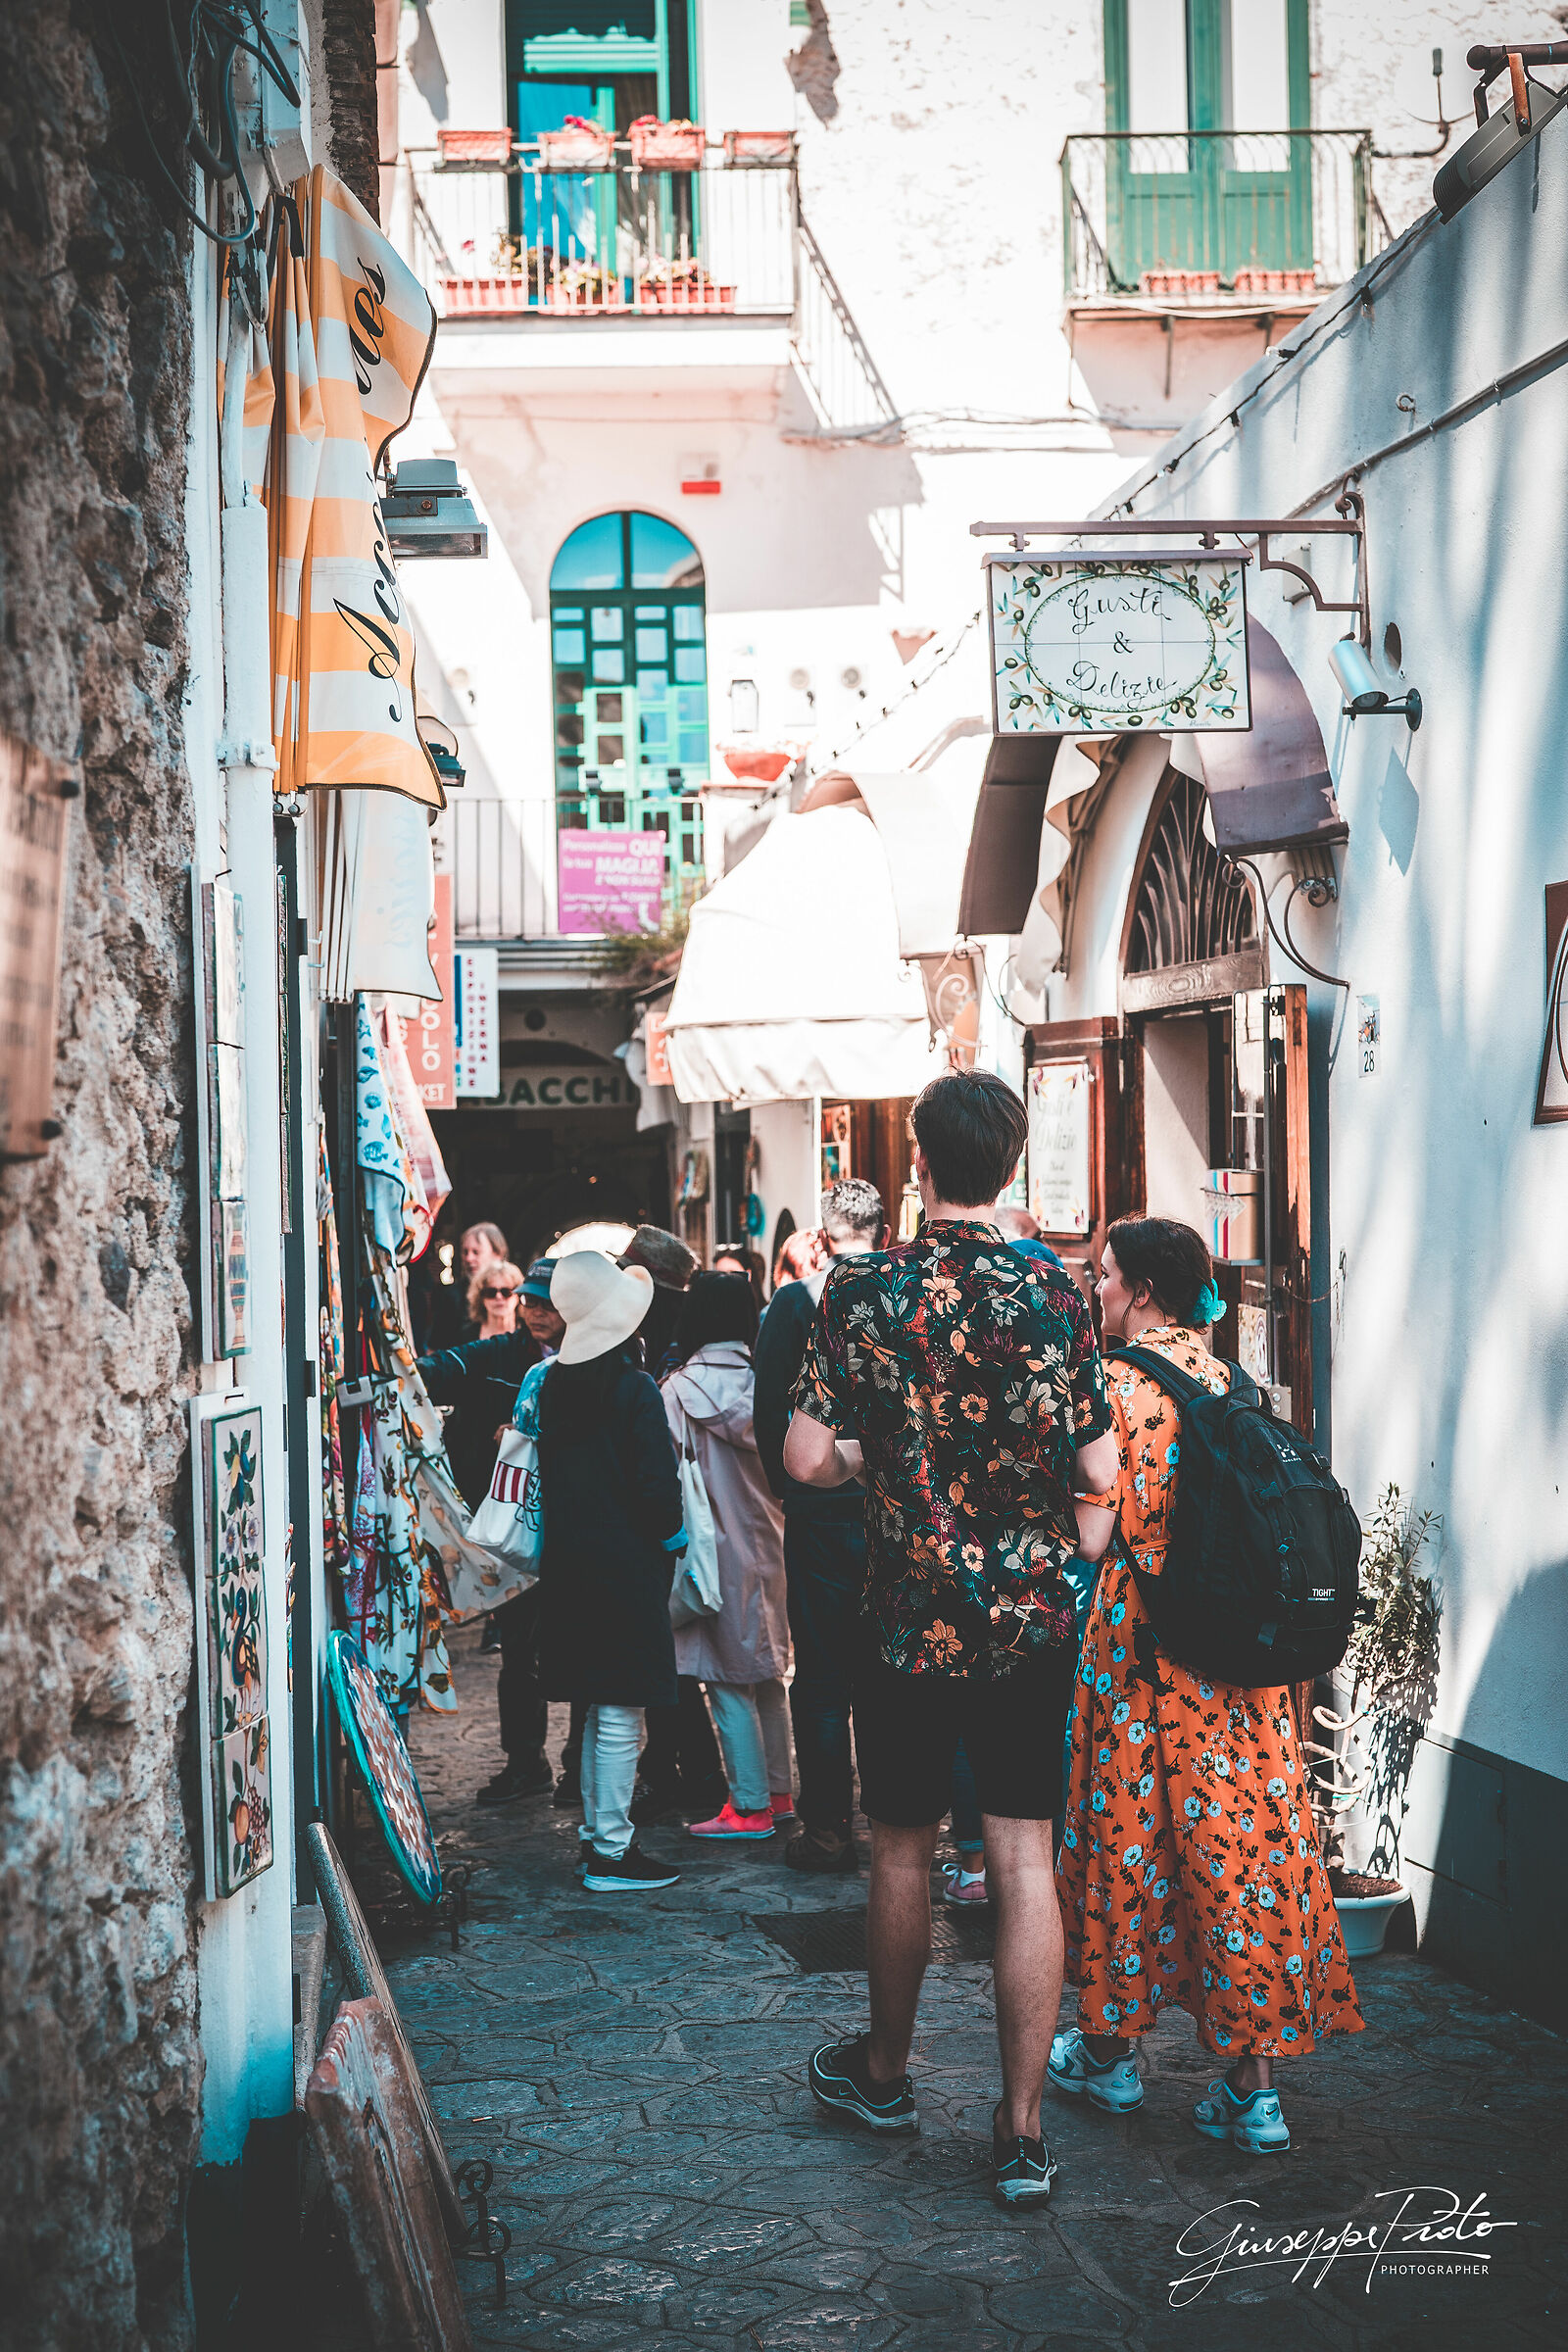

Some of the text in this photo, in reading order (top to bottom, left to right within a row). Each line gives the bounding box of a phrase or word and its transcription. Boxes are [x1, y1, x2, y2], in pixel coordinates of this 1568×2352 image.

[1067, 587, 1173, 635] Gusti
[1112, 630, 1134, 654] &
[1065, 660, 1178, 710] Delizie
[1363, 1050, 1376, 1073] 28
